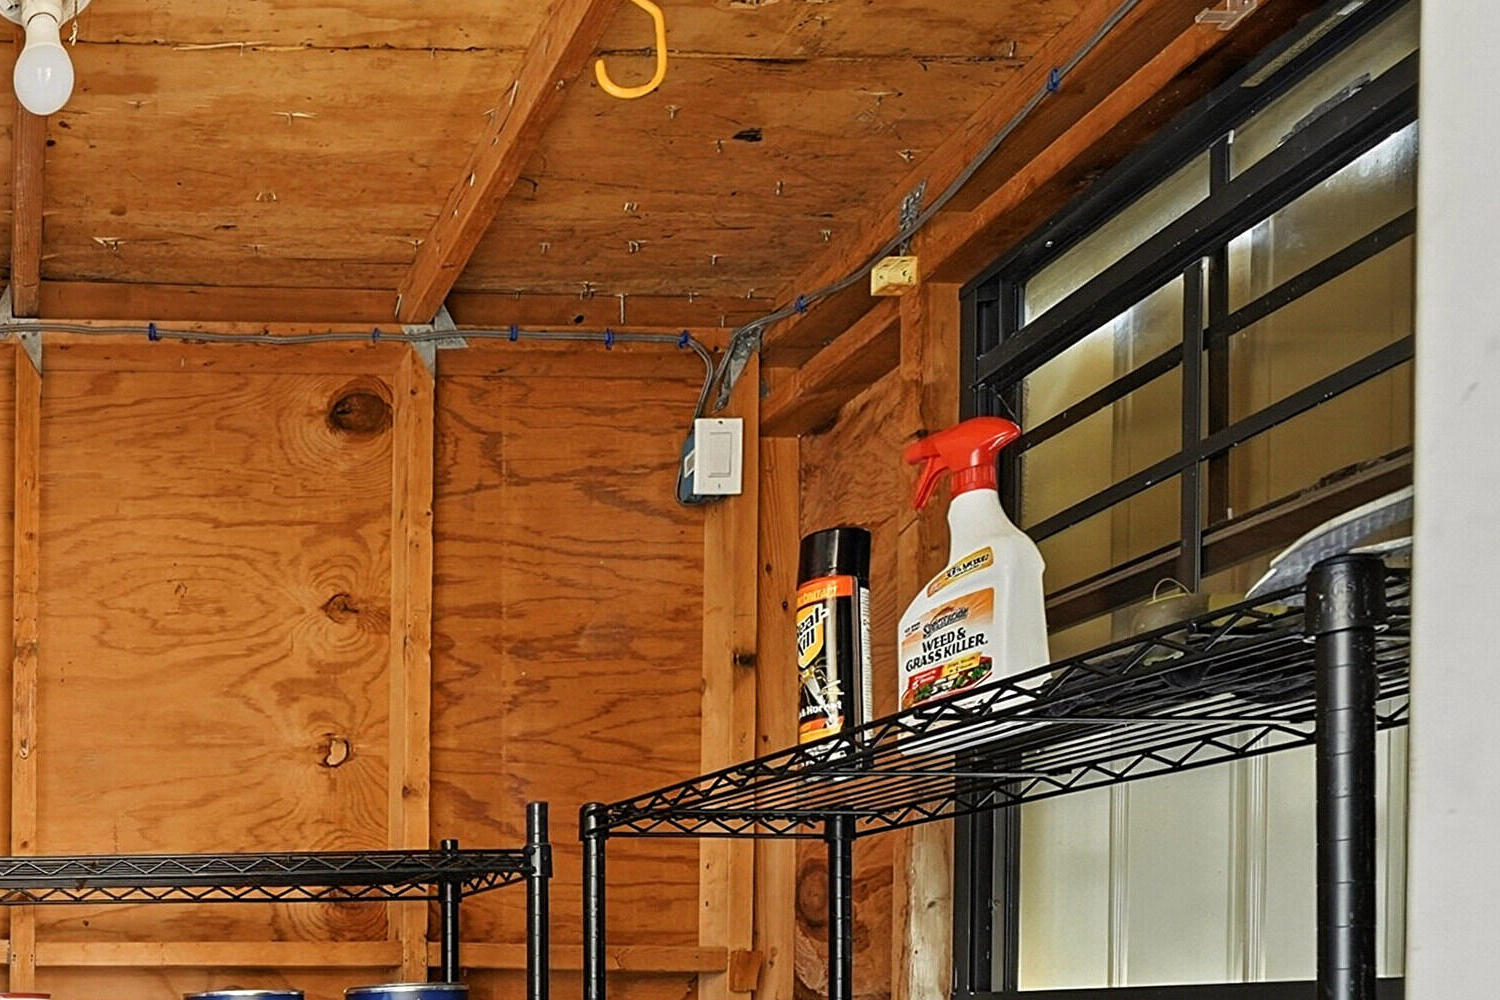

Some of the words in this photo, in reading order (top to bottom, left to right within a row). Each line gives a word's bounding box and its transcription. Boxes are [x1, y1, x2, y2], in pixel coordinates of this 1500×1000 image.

[921, 631, 955, 654] WEED
[956, 626, 966, 641] &
[905, 650, 942, 673] GRASS
